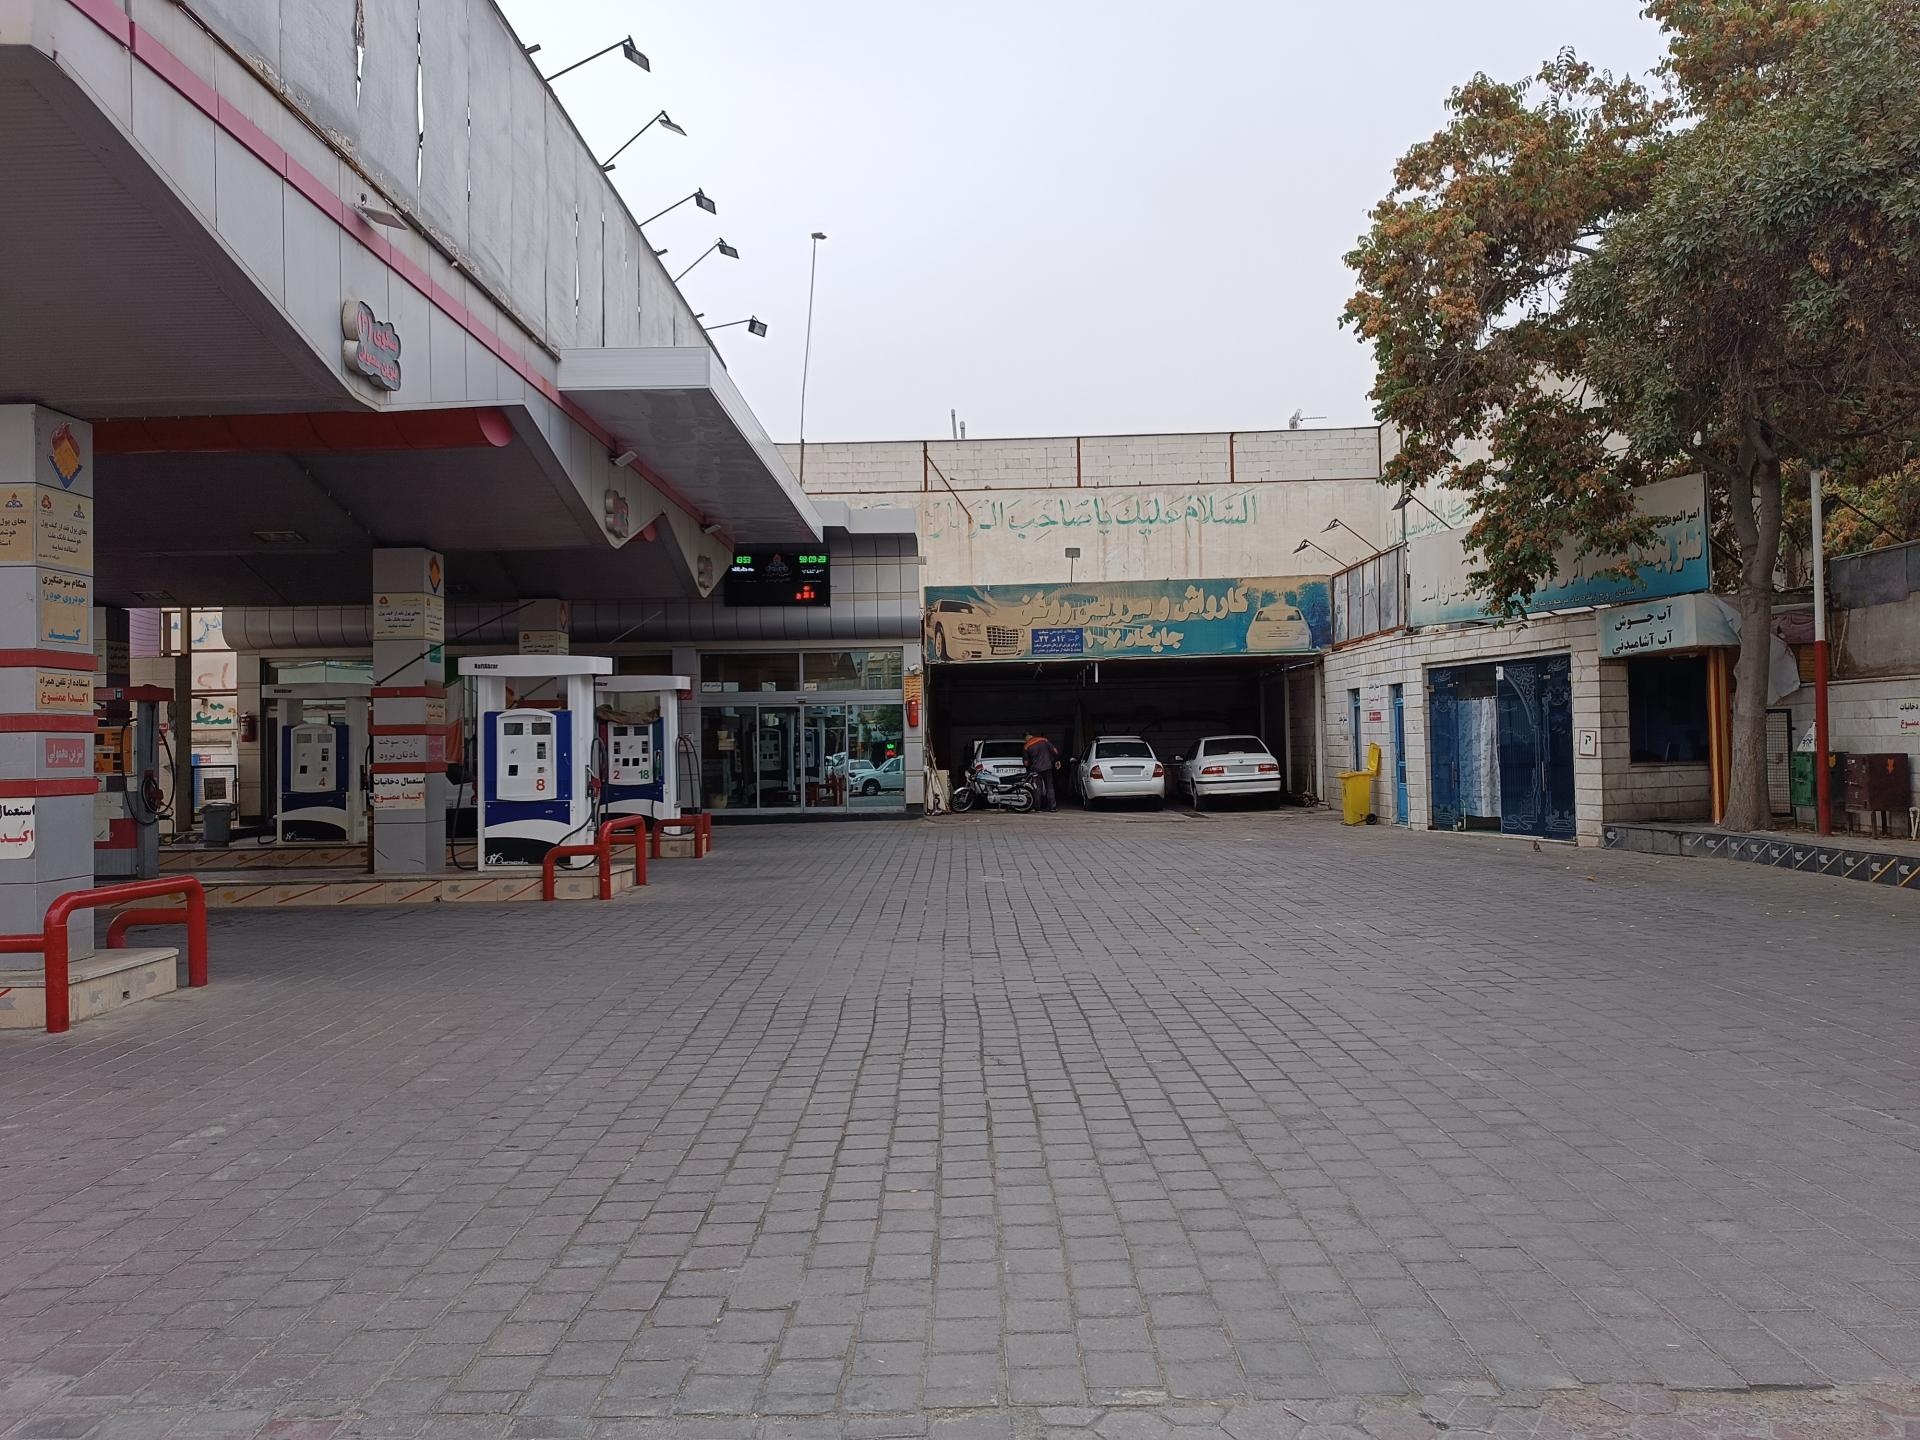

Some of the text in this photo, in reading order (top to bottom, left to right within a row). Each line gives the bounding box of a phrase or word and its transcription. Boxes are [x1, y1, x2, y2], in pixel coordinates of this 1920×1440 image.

[41, 576, 87, 589] هنگام سوختگیری
[1173, 584, 1249, 622] کارواش
[1614, 604, 1673, 631] آب جوش
[1124, 624, 1185, 653] جایگاه
[1611, 630, 1673, 655] آب آشامیدنی
[39, 676, 90, 689] استفاده از تلفن همراه
[40, 691, 67, 705] ممنوع
[613, 770, 620, 779] 2
[638, 769, 650, 779] 18
[319, 776, 326, 786] 4
[373, 777, 426, 787] استعمال دخانیات
[535, 778, 546, 791] 8
[374, 792, 401, 804] ممنوع
[0, 829, 34, 846] اکید
